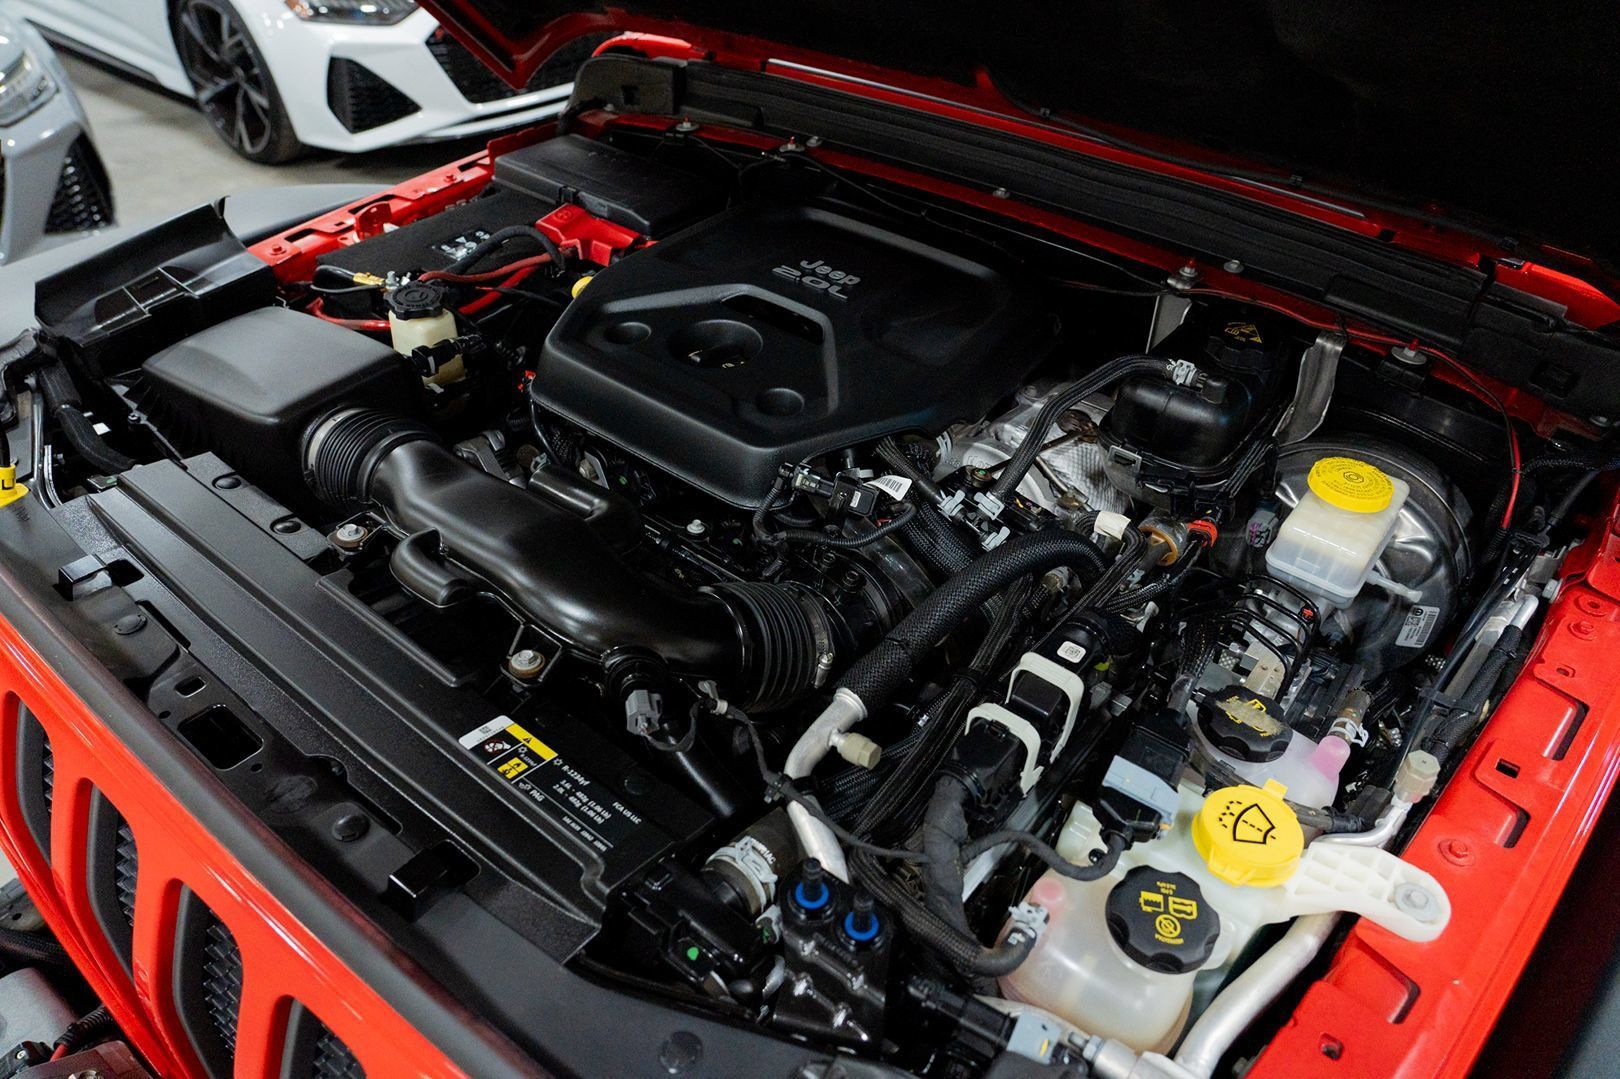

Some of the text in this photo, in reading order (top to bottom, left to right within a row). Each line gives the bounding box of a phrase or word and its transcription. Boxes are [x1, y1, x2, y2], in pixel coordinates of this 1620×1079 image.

[772, 264, 848, 299] 2.0L
[800, 259, 862, 285] Jeep
[559, 779, 573, 790] 3.6L
[561, 765, 591, 786] R-1234yf
[529, 789, 546, 802] PAG
[552, 784, 566, 795] 2.0L
[612, 801, 642, 825] FCA US LLC
